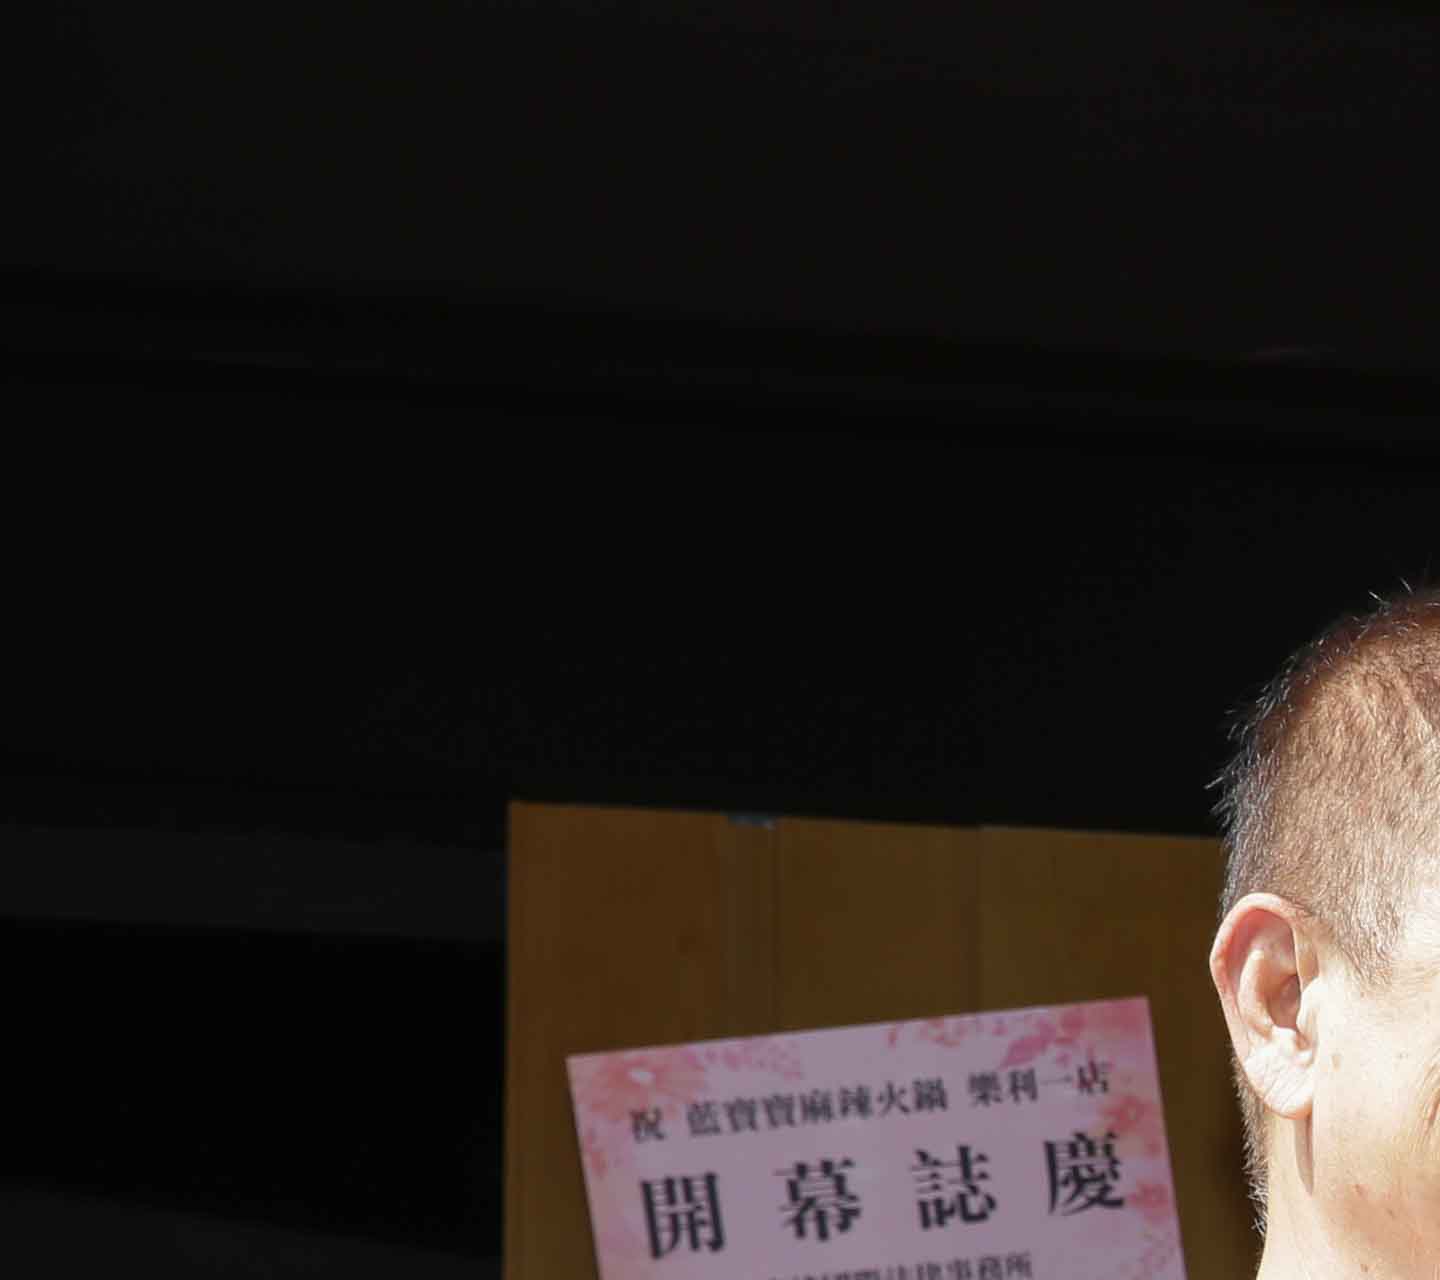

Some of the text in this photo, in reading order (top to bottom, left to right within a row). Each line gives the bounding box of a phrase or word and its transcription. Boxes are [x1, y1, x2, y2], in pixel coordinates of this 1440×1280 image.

[630, 1107, 666, 1142] 祝
[638, 1131, 1125, 1260] 開幕誌慶
